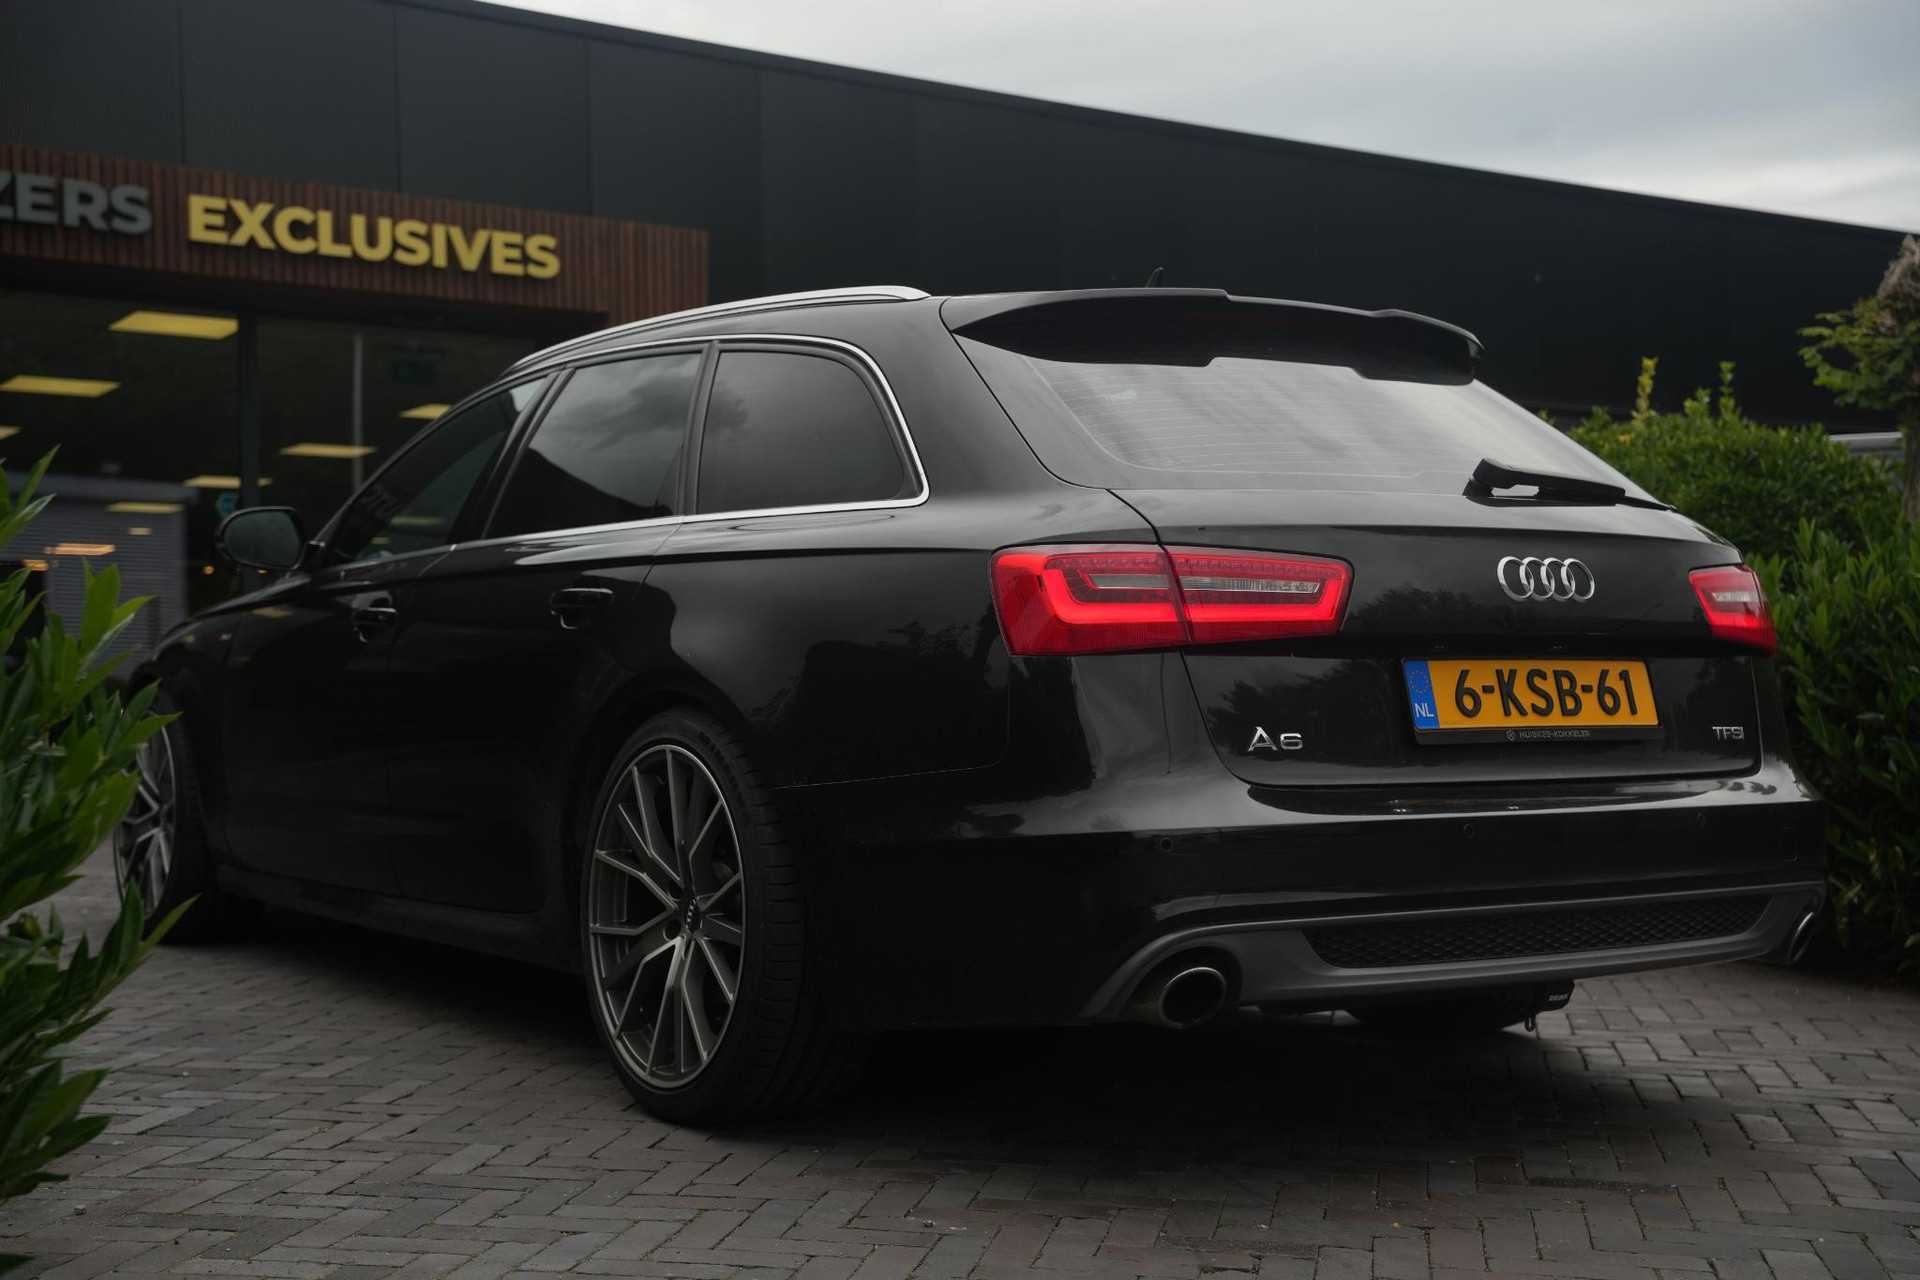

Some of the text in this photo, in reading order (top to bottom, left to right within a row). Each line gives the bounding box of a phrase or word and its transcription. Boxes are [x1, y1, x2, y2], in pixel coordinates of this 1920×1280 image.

[187, 193, 562, 281] EXCLUSIVES
[1455, 668, 1638, 718] 6-KSB-61
[1414, 702, 1434, 718] NL
[1246, 726, 1303, 752] A6
[1711, 726, 1745, 741] TFSI
